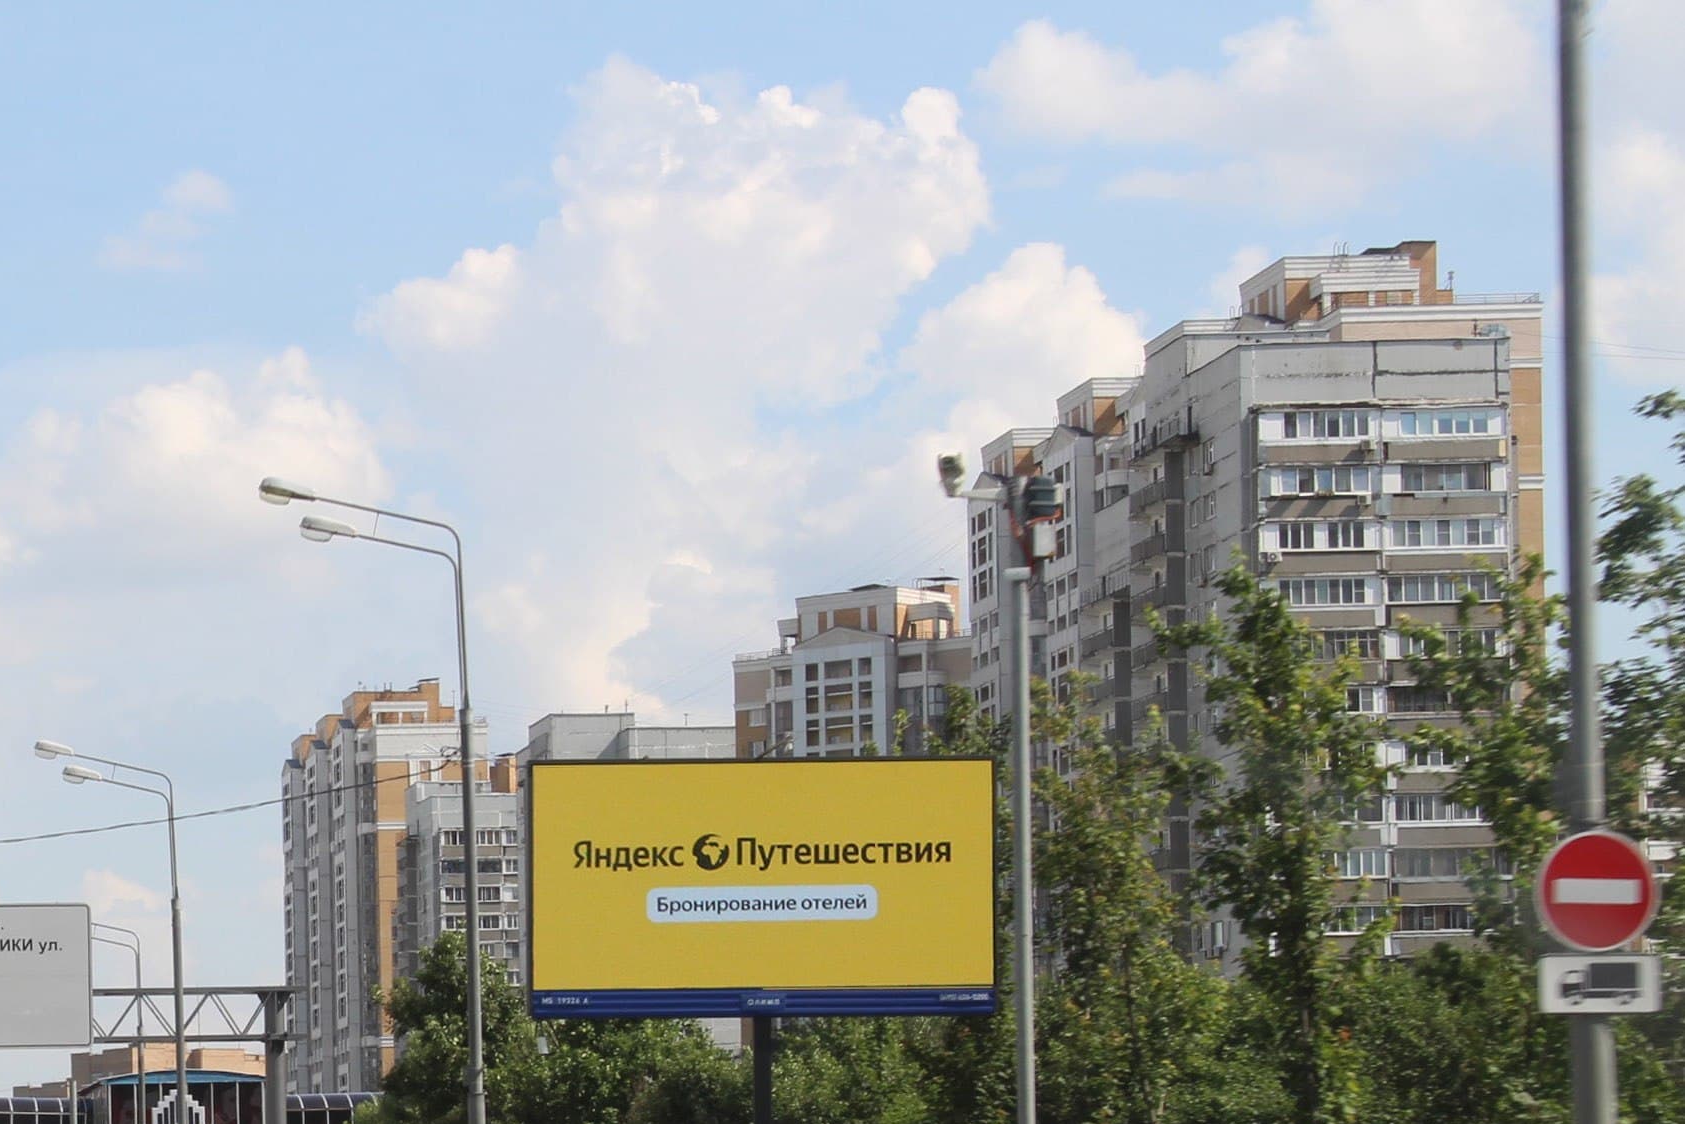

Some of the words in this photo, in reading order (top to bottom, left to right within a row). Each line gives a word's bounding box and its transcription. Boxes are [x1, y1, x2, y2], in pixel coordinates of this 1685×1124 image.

[573, 840, 684, 871] Яндекс
[735, 836, 952, 871] Путешествия
[656, 895, 797, 916] Бронирование
[800, 893, 867, 911] отелей
[38, 939, 63, 954] ул.
